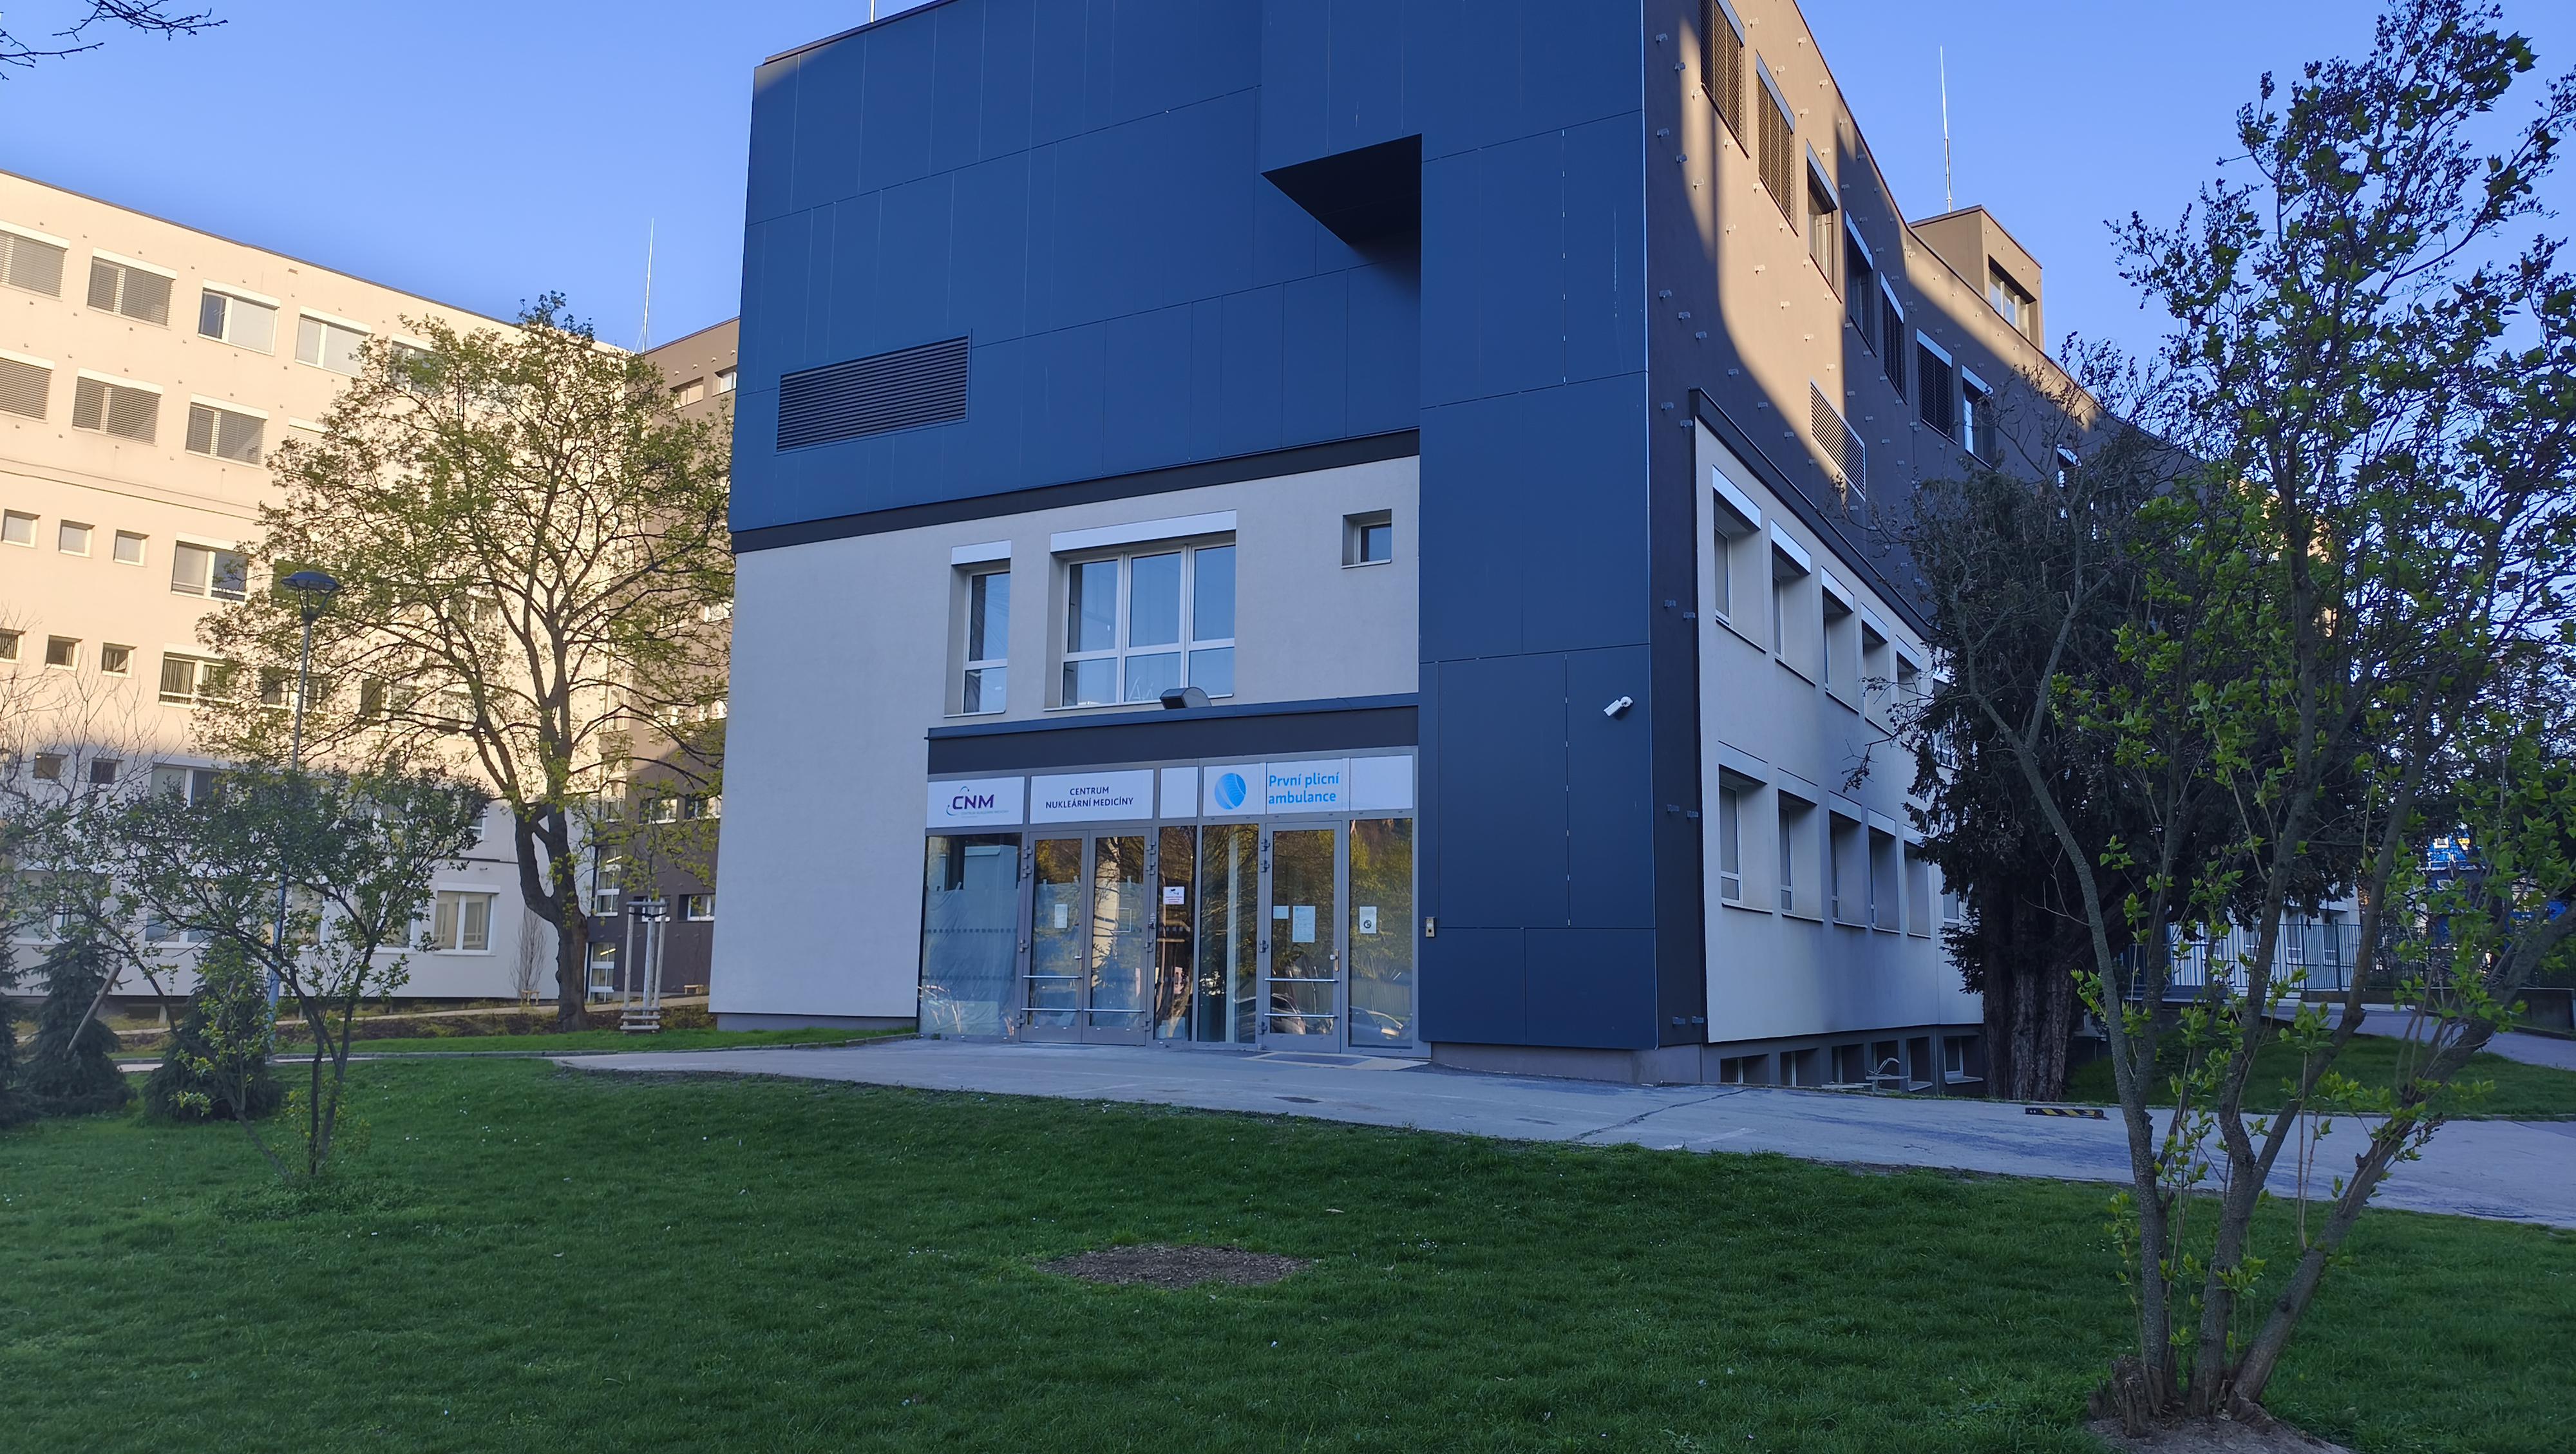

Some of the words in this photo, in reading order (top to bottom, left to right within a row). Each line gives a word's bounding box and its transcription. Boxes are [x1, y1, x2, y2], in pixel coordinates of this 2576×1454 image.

[1269, 773, 1302, 787] První
[1305, 772, 1340, 788] plicní
[1070, 786, 1109, 796] CENTRUM
[1268, 790, 1336, 804] ambulance
[952, 794, 994, 809] CNM
[1045, 797, 1092, 809] NUKLEÁRNÍ
[1093, 796, 1133, 806] MEDICÍNY
